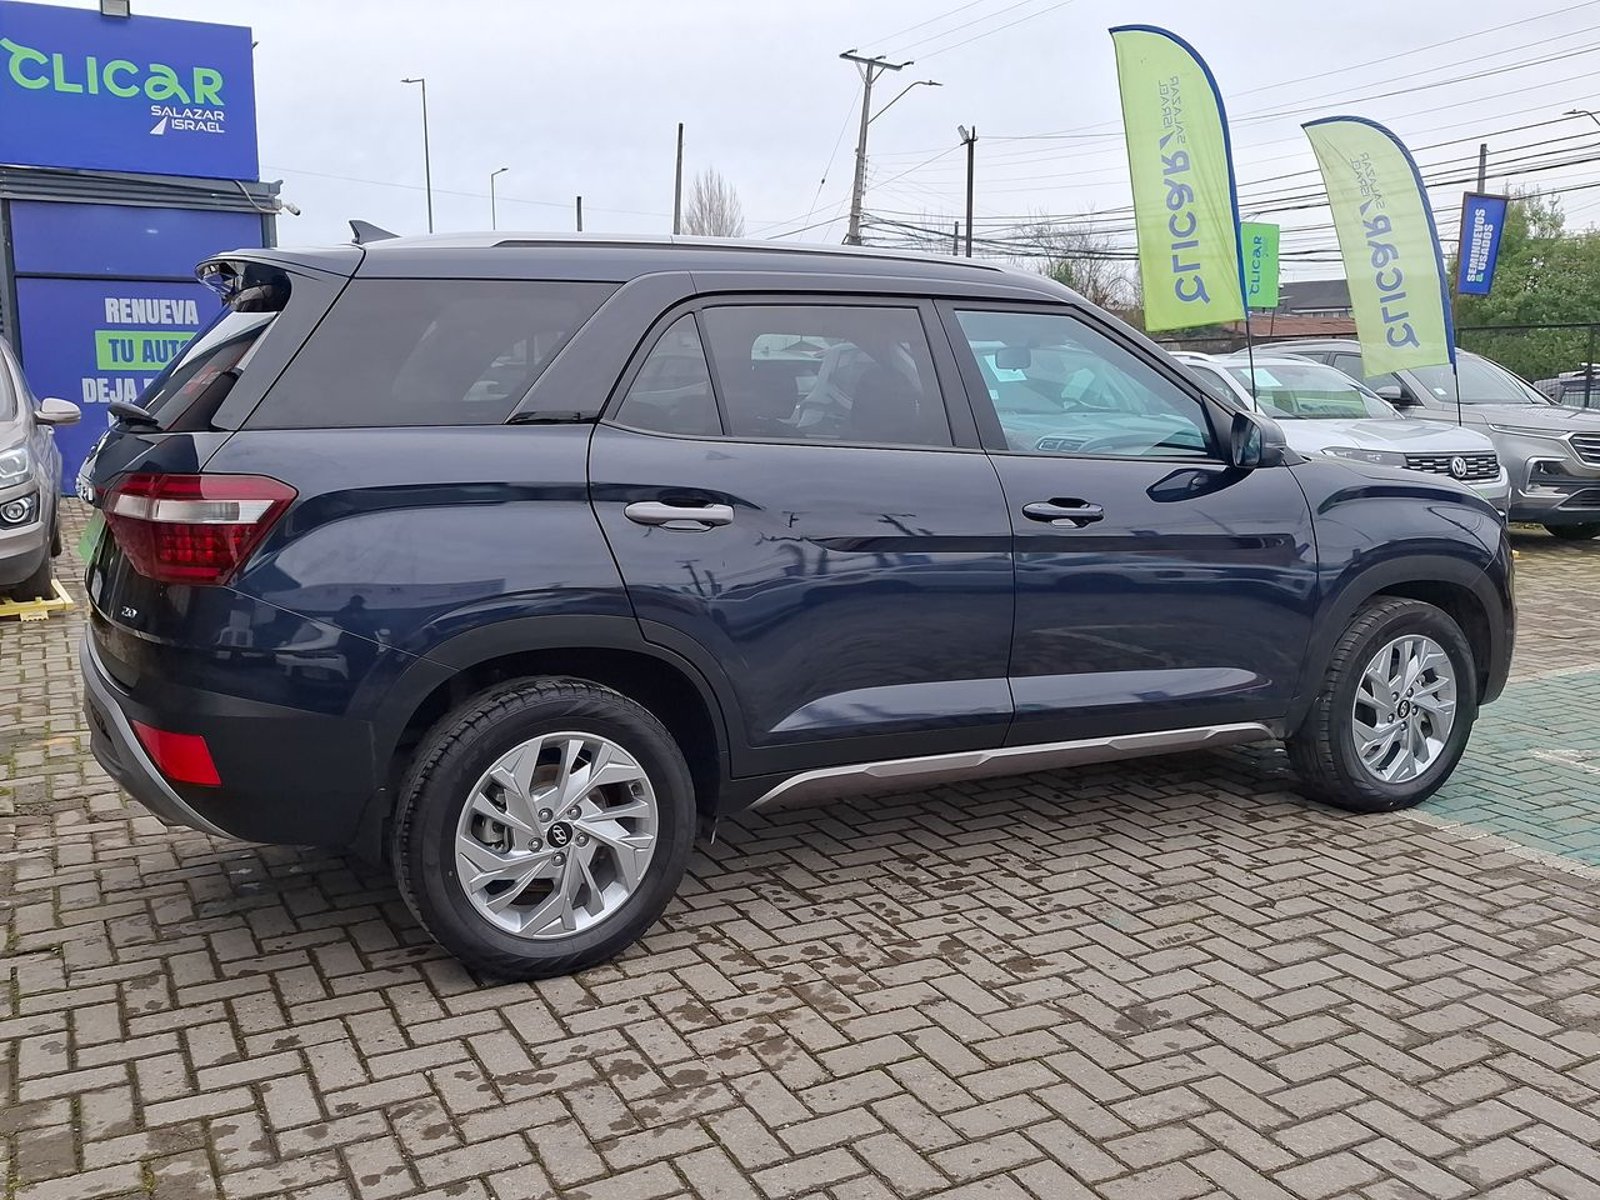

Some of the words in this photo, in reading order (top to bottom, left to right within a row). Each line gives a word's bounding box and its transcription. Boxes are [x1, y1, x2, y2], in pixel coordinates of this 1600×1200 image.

[150, 105, 225, 121] SALAZAR
[171, 118, 225, 134] ISRAEL
[1466, 208, 1486, 282] SEMINUEVOS
[1477, 223, 1494, 271] USADOS
[104, 297, 200, 325] RENUEVA
[108, 338, 135, 363] TU
[142, 339, 189, 363] AUT
[81, 377, 138, 403] DEJA
